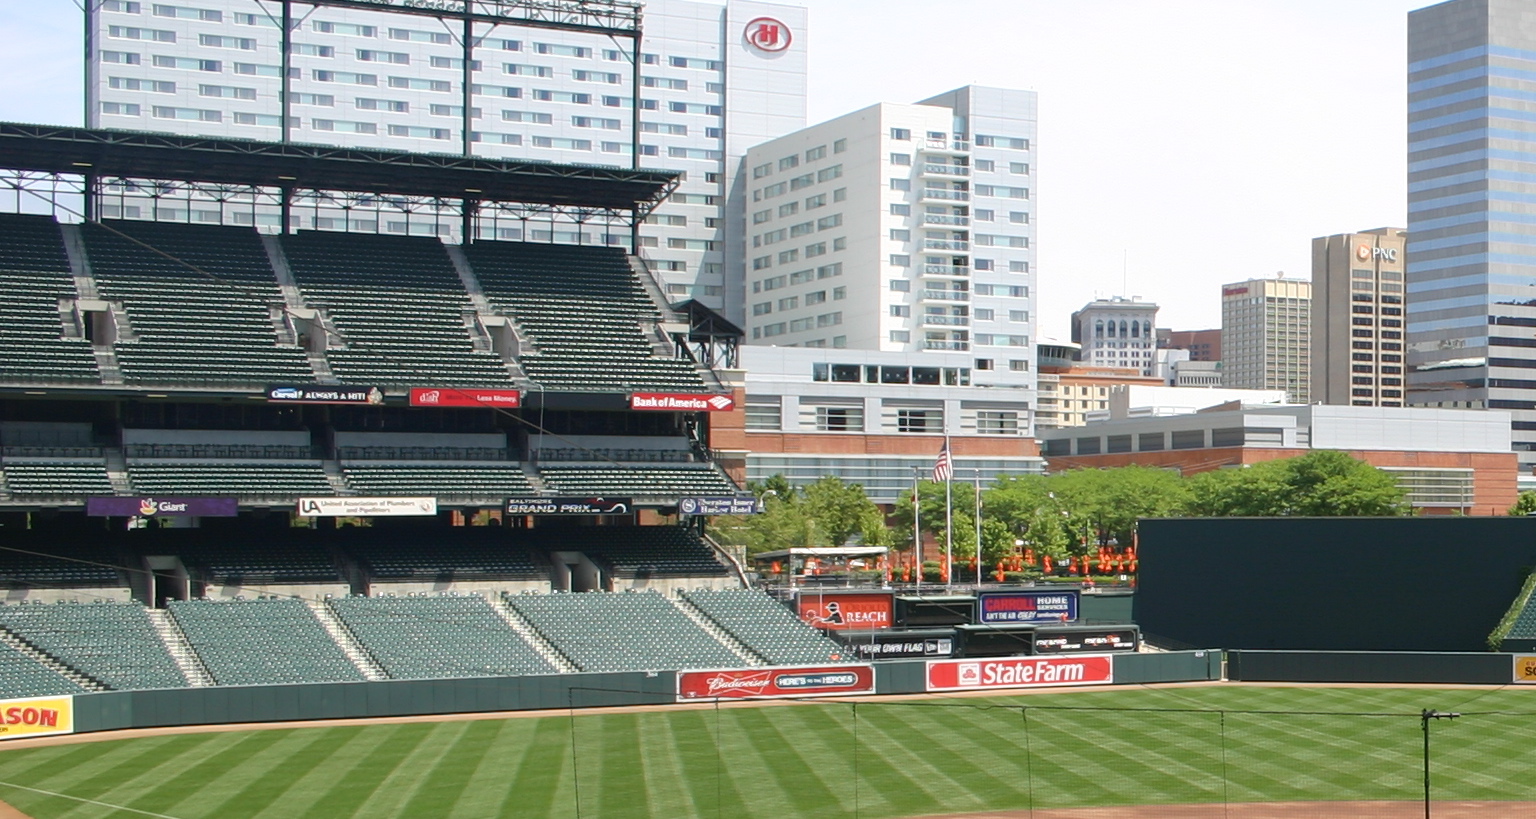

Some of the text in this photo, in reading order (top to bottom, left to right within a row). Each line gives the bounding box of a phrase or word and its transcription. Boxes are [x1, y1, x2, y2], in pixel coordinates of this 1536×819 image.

[1372, 247, 1397, 260] PNC
[633, 396, 708, 408] Bank of America
[159, 501, 186, 511] Giant
[301, 500, 322, 514] UA
[508, 505, 591, 513] GRAND PRIX
[1037, 596, 1068, 604] HOME
[846, 612, 887, 622] REACH
[904, 643, 922, 653] FLAG
[706, 677, 770, 689] Budweiser
[823, 676, 853, 684] HEROES
[0, 707, 59, 727] SON
